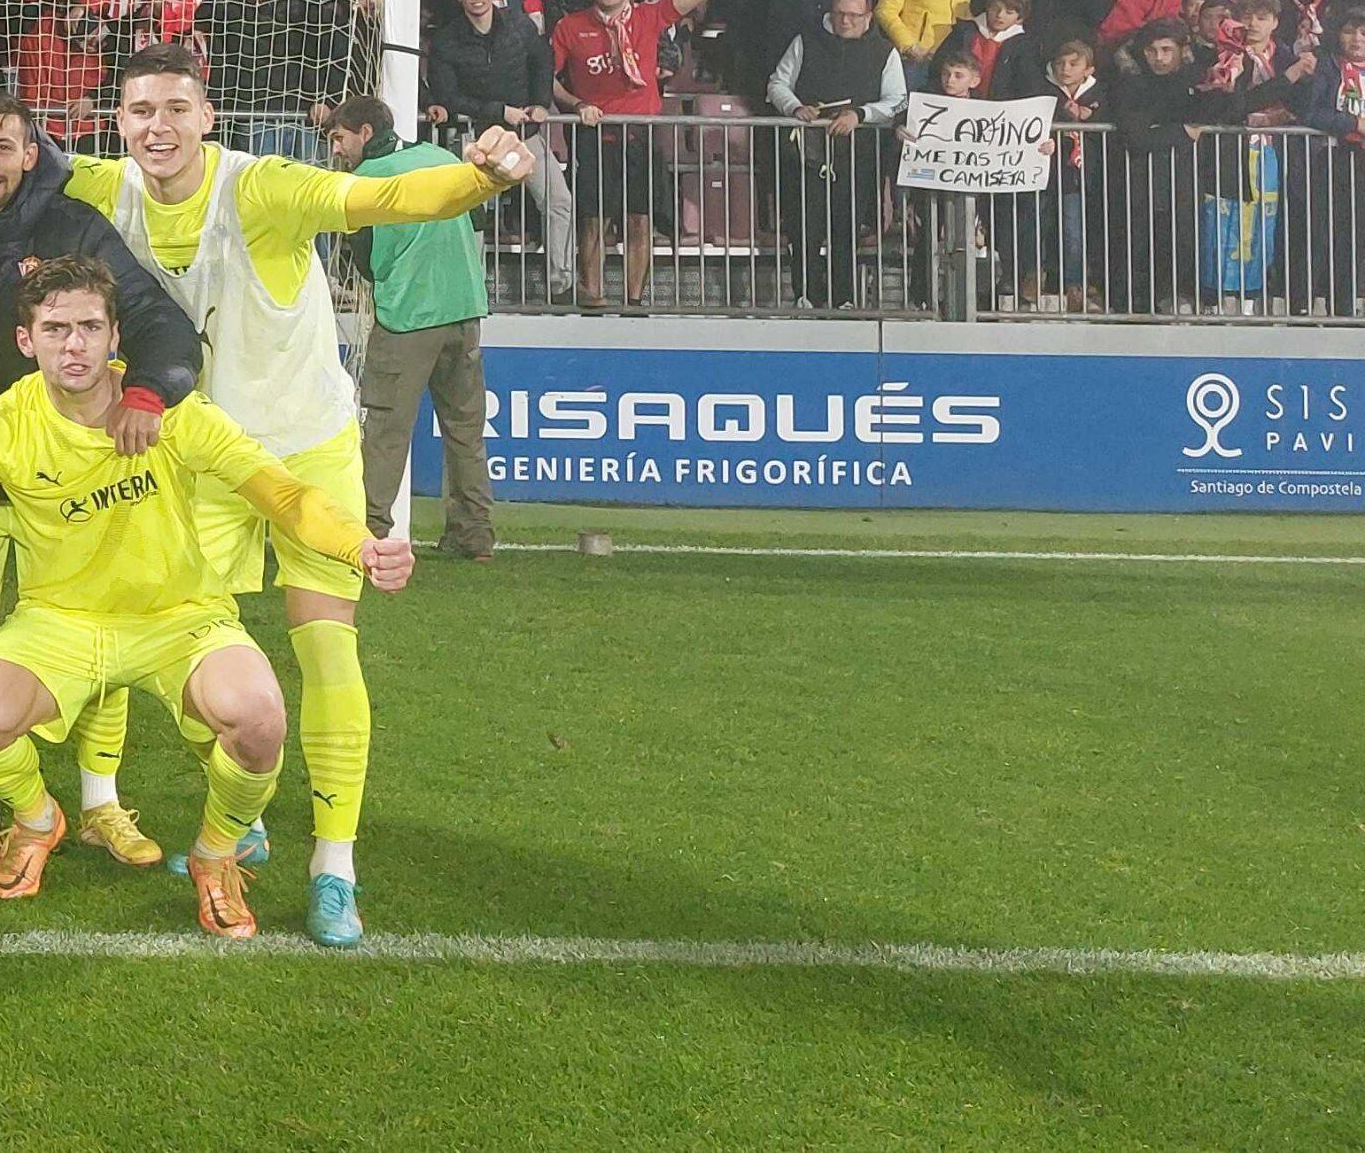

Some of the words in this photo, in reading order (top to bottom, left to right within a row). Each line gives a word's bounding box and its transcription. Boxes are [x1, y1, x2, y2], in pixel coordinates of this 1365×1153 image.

[953, 150, 992, 167] DAS
[939, 168, 1027, 189] CAMISETA
[1266, 431, 1355, 453] PAVI
[486, 451, 663, 484] GENIERÍA
[675, 452, 914, 488] FRIGORÍFICA
[1189, 479, 1254, 497] Santiago
[1256, 480, 1275, 495] de
[1277, 480, 1363, 498] Compostela
